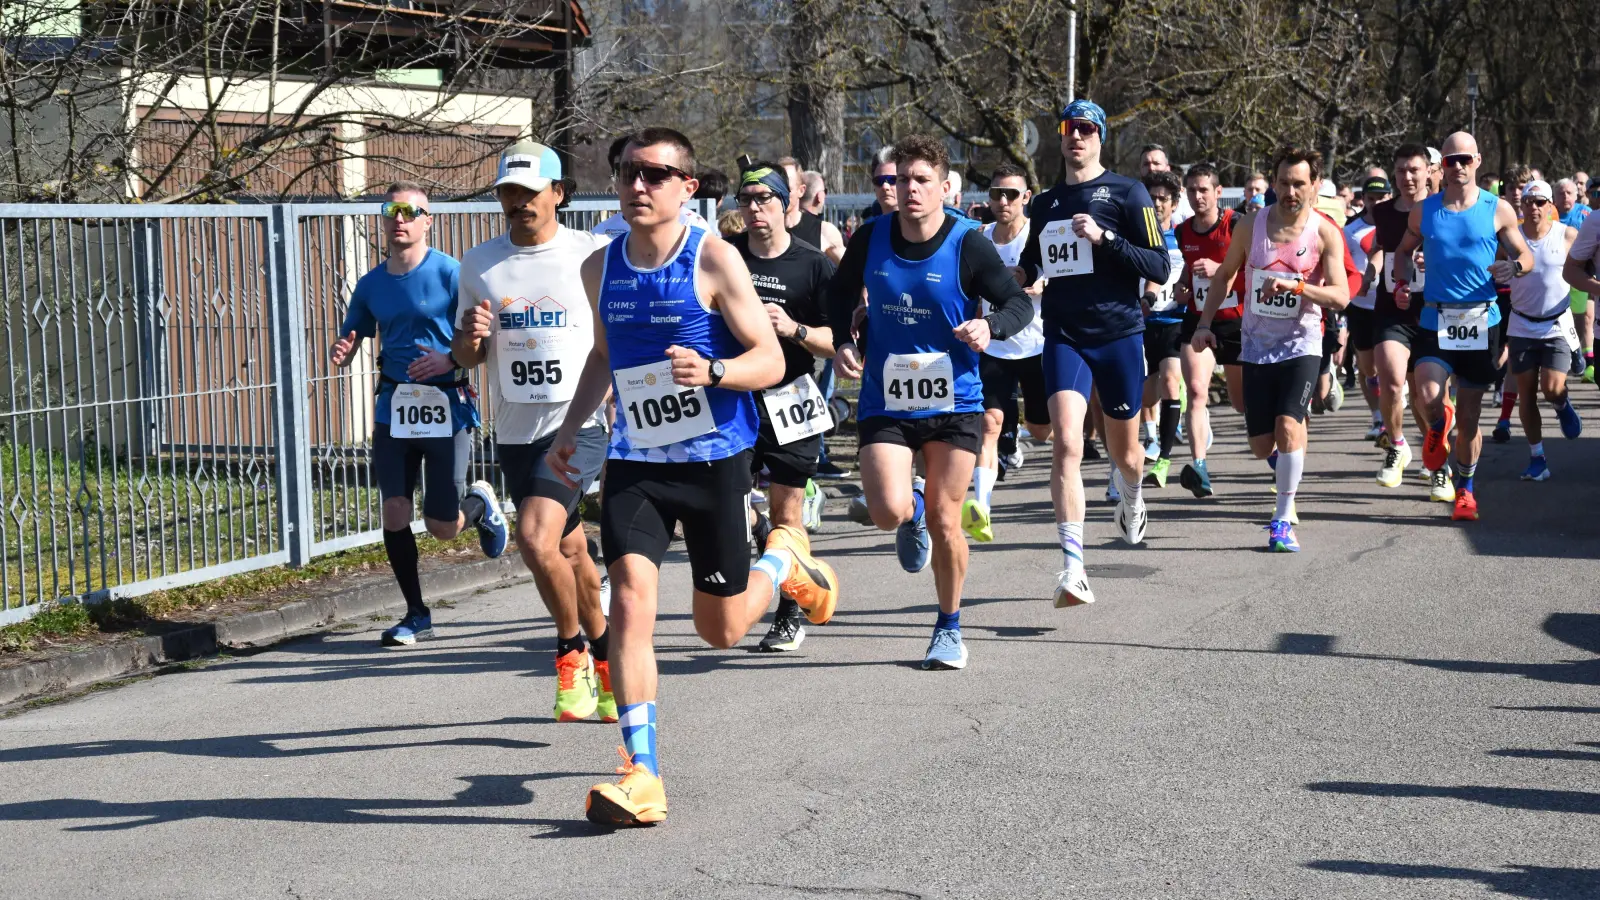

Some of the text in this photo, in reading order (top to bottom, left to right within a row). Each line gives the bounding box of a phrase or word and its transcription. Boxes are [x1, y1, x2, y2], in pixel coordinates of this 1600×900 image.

[1048, 242, 1078, 264] 941
[750, 273, 779, 284] eam
[754, 281, 786, 290] RNSBERG
[651, 315, 682, 323] bender
[1447, 326, 1478, 340] 904
[511, 360, 562, 386] 955
[888, 378, 948, 399] 4103
[396, 406, 446, 424] 1063
[628, 389, 701, 429] 1095
[775, 396, 825, 428] 1029
